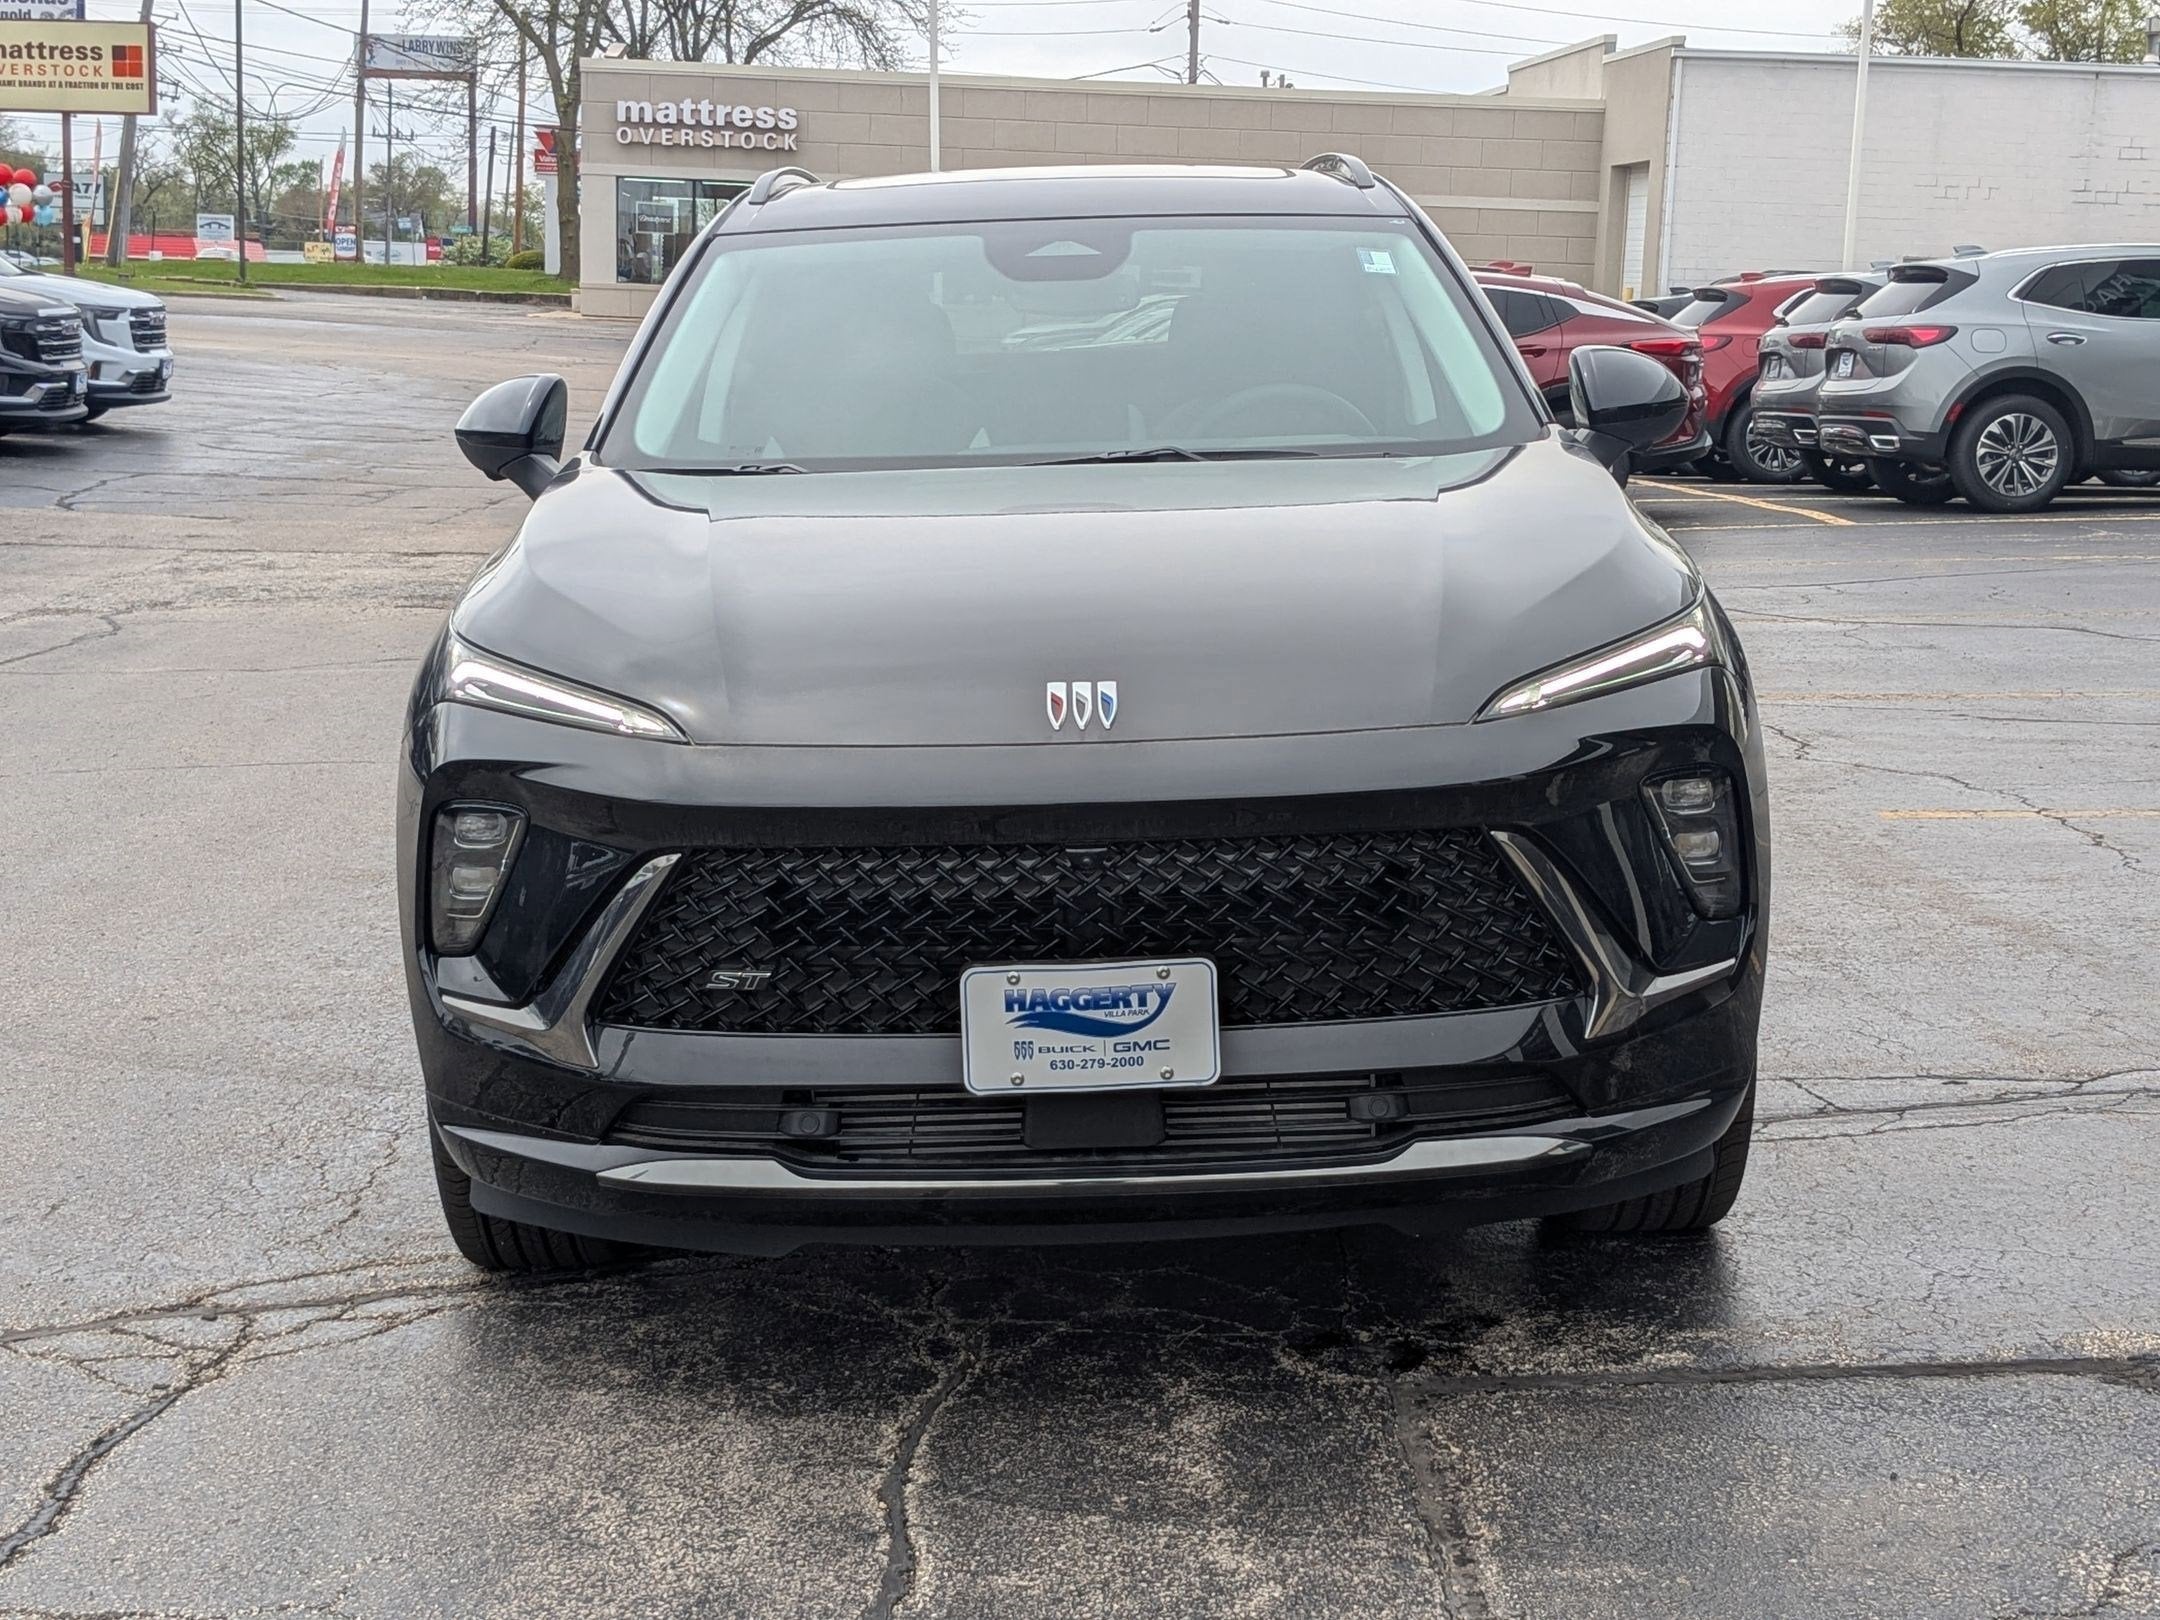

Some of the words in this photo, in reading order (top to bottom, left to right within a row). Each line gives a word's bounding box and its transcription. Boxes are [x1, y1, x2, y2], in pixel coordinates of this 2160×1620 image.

[0, 41, 103, 61] attress
[402, 39, 434, 54] LARRY
[18, 80, 47, 89] BRANDS
[48, 81, 57, 89] AT
[58, 81, 64, 89] A
[65, 81, 99, 90] FRACTION
[101, 82, 110, 90] OF
[111, 82, 124, 90] THE
[125, 83, 144, 91] COST
[616, 98, 798, 130] mattress
[616, 127, 798, 151] OVERSTOCK
[335, 236, 357, 246] OPEN
[706, 971, 772, 990] ST
[1004, 982, 1177, 1013] HAGGERTY
[1104, 1010, 1126, 1018] VILLA
[1127, 1008, 1150, 1017] PARK
[1038, 1044, 1098, 1054] BUICK
[1113, 1039, 1171, 1053] GMC
[1050, 1055, 1145, 1071] 630-279-2000
